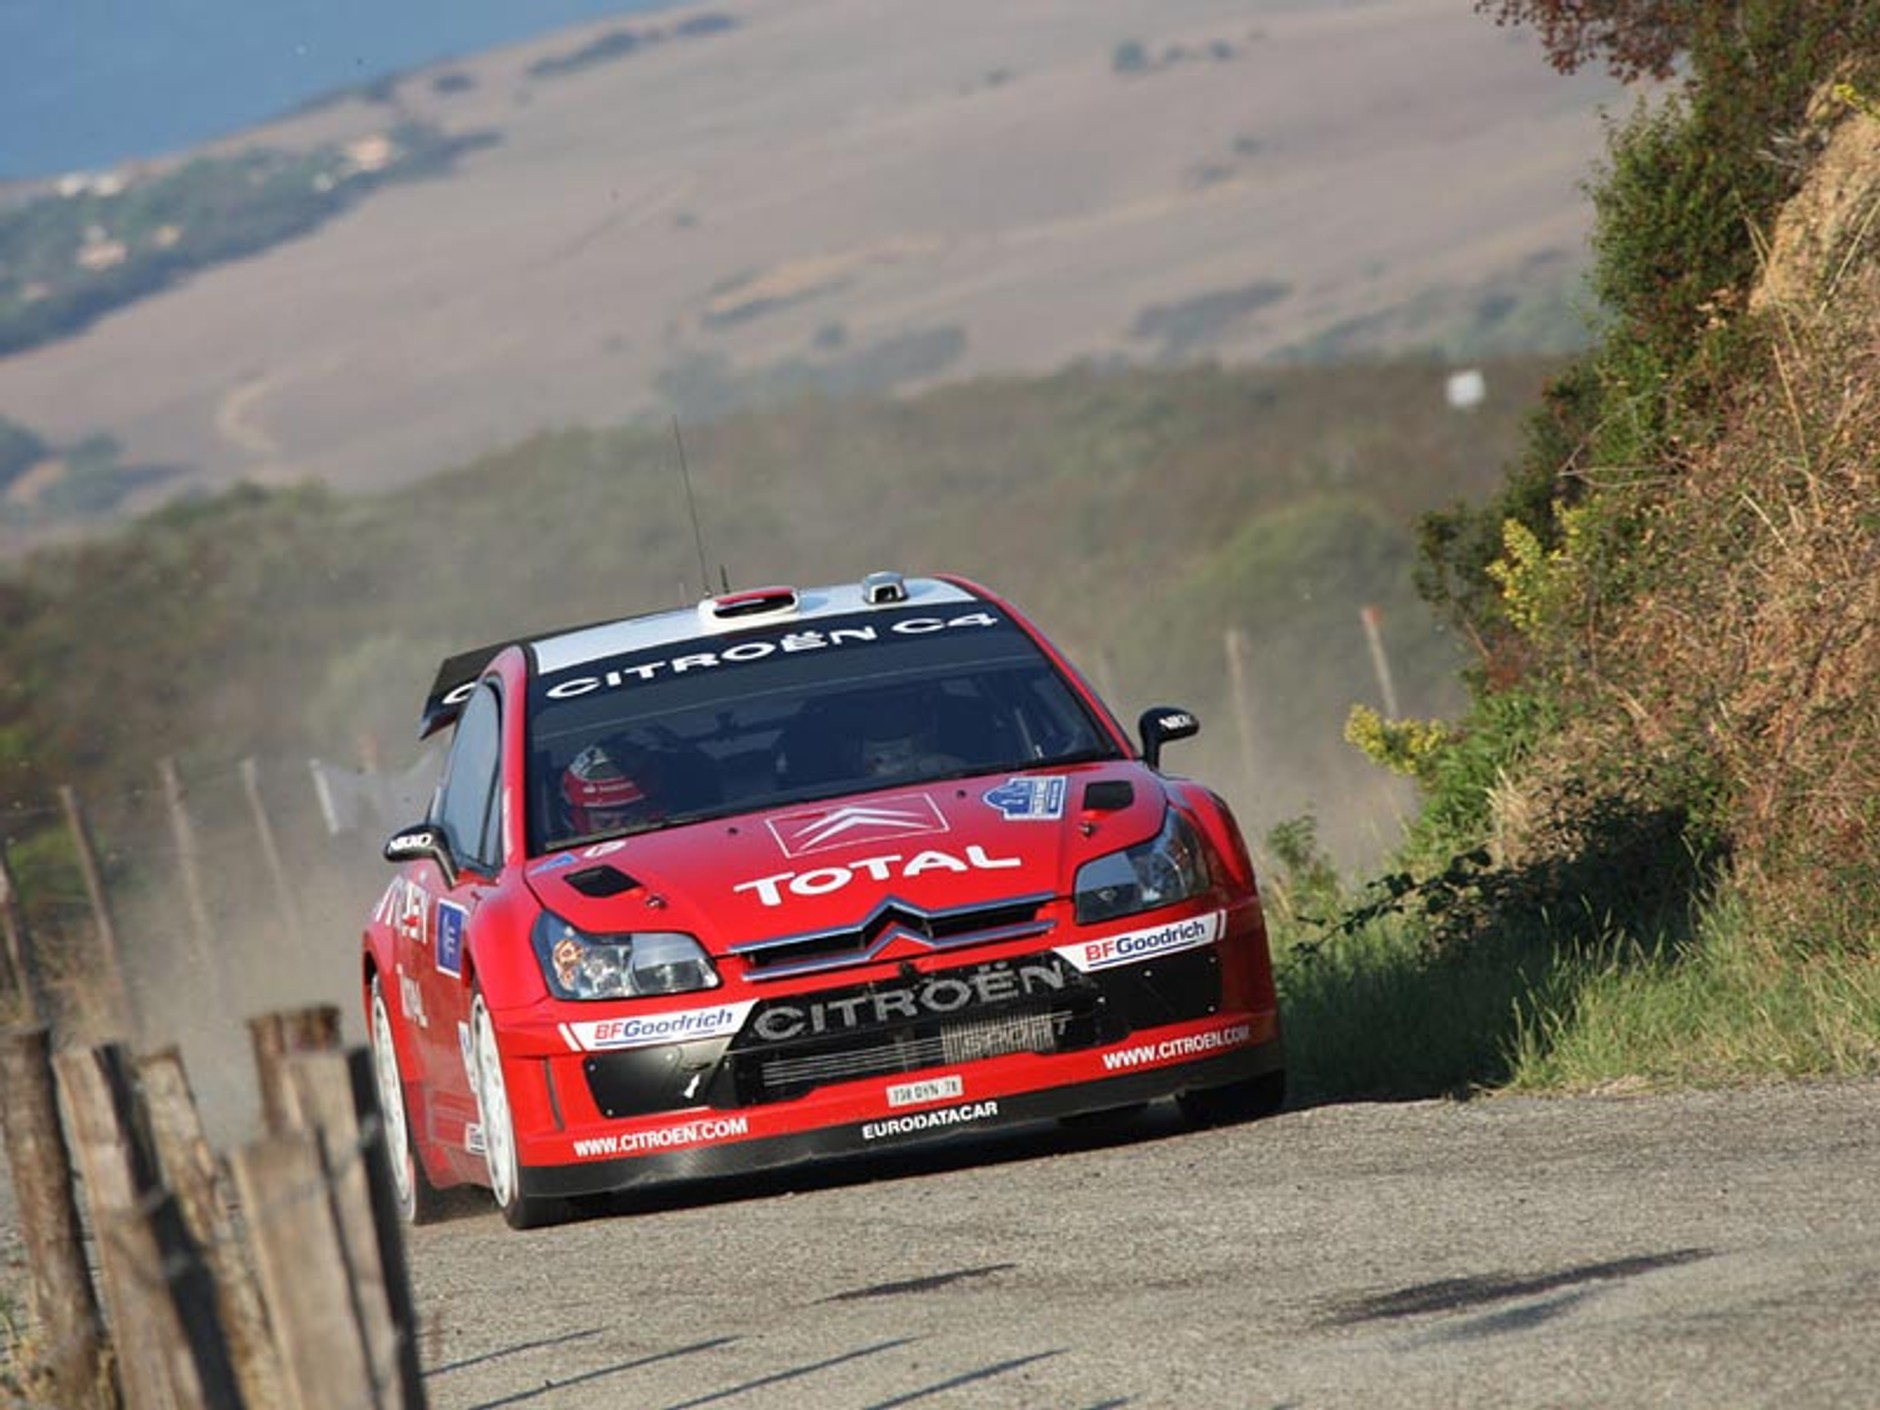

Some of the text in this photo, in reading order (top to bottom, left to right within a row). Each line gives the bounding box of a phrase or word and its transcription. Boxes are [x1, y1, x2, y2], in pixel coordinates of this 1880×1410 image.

[546, 612, 998, 699] CITROËN C4
[733, 845, 1022, 907] TOTAL
[1085, 920, 1206, 962] BFGoodrich
[754, 960, 1065, 1040] CITROËN
[594, 1008, 734, 1041] BFGoodrich
[1102, 1024, 1250, 1070] WWW.CITROEN.COM
[572, 1117, 749, 1158] WWW.CITROEN.COM
[861, 1100, 998, 1140] EURODATACAR
